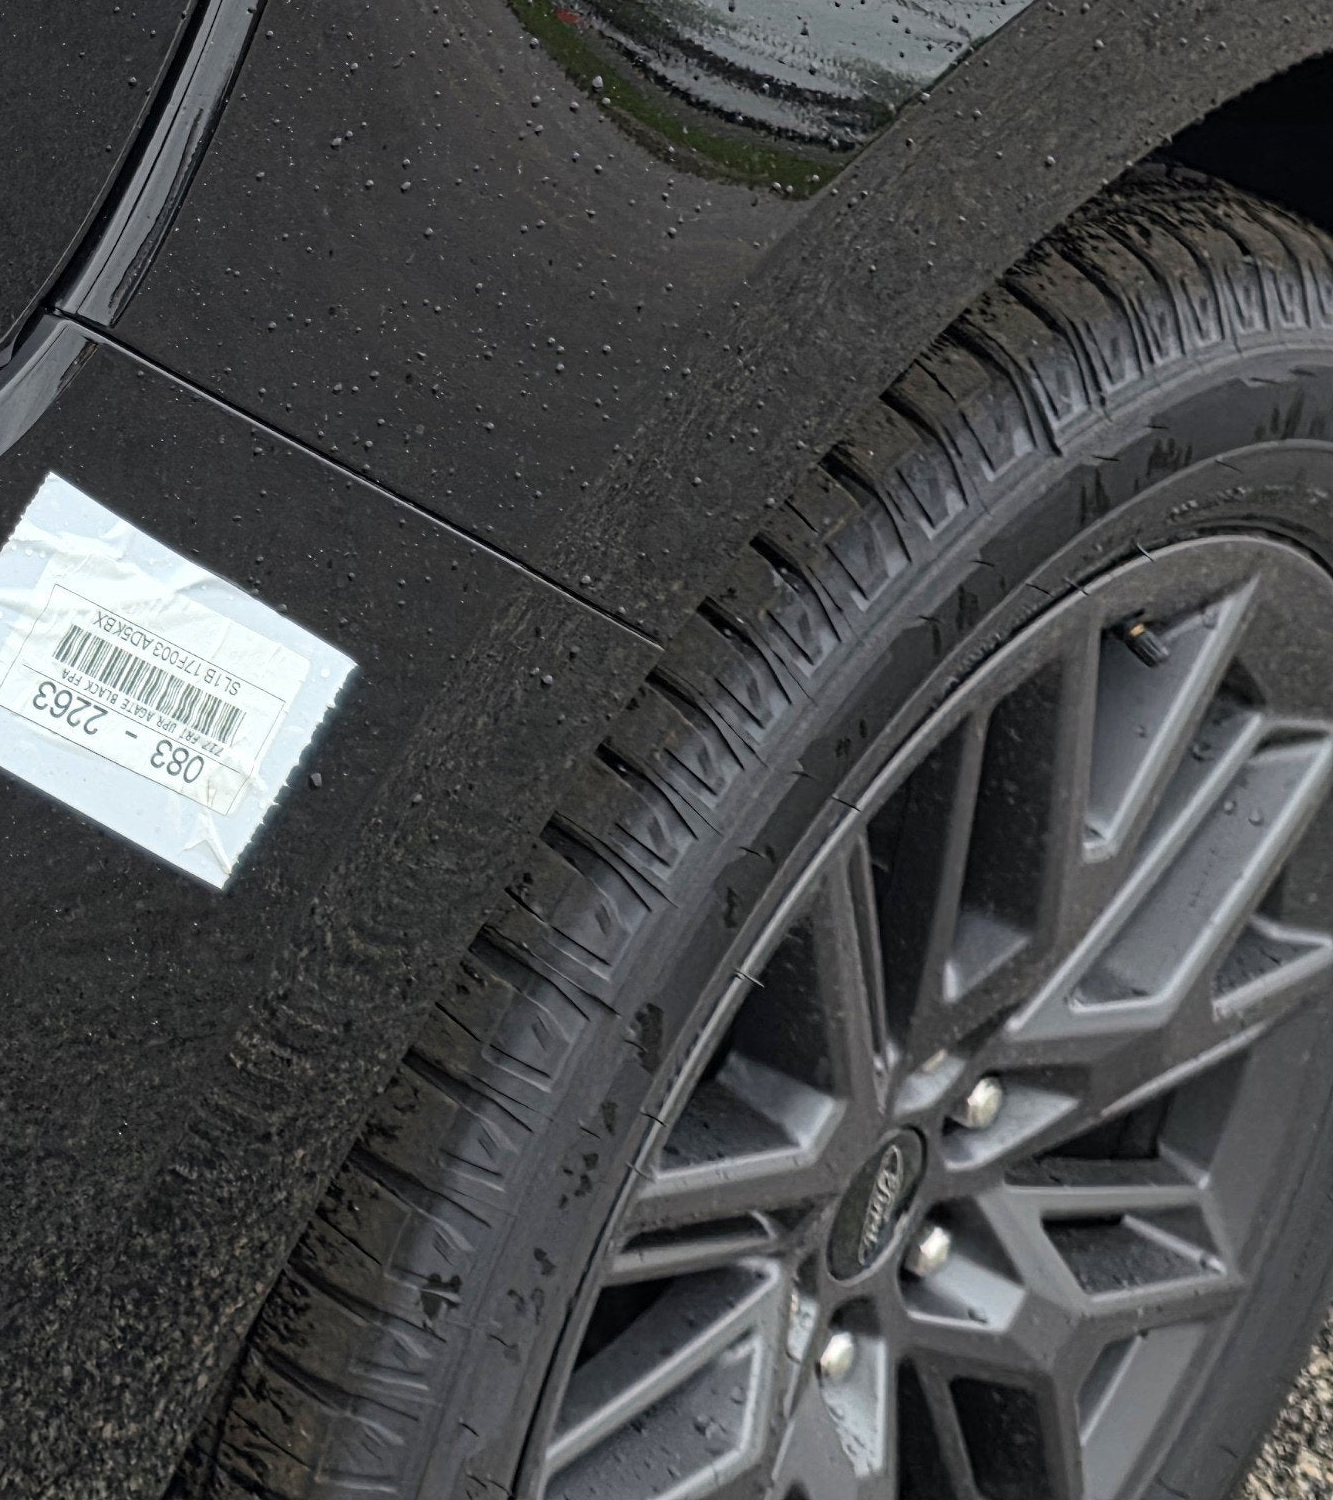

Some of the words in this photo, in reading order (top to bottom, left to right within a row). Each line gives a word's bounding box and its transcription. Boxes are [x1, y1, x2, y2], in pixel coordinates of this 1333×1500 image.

[60, 668, 82, 686] FPA
[83, 680, 118, 705] BLACK
[31, 680, 109, 736] 2263
[120, 698, 155, 723] AGATE
[155, 715, 177, 734] UPR
[149, 739, 205, 784] 083
